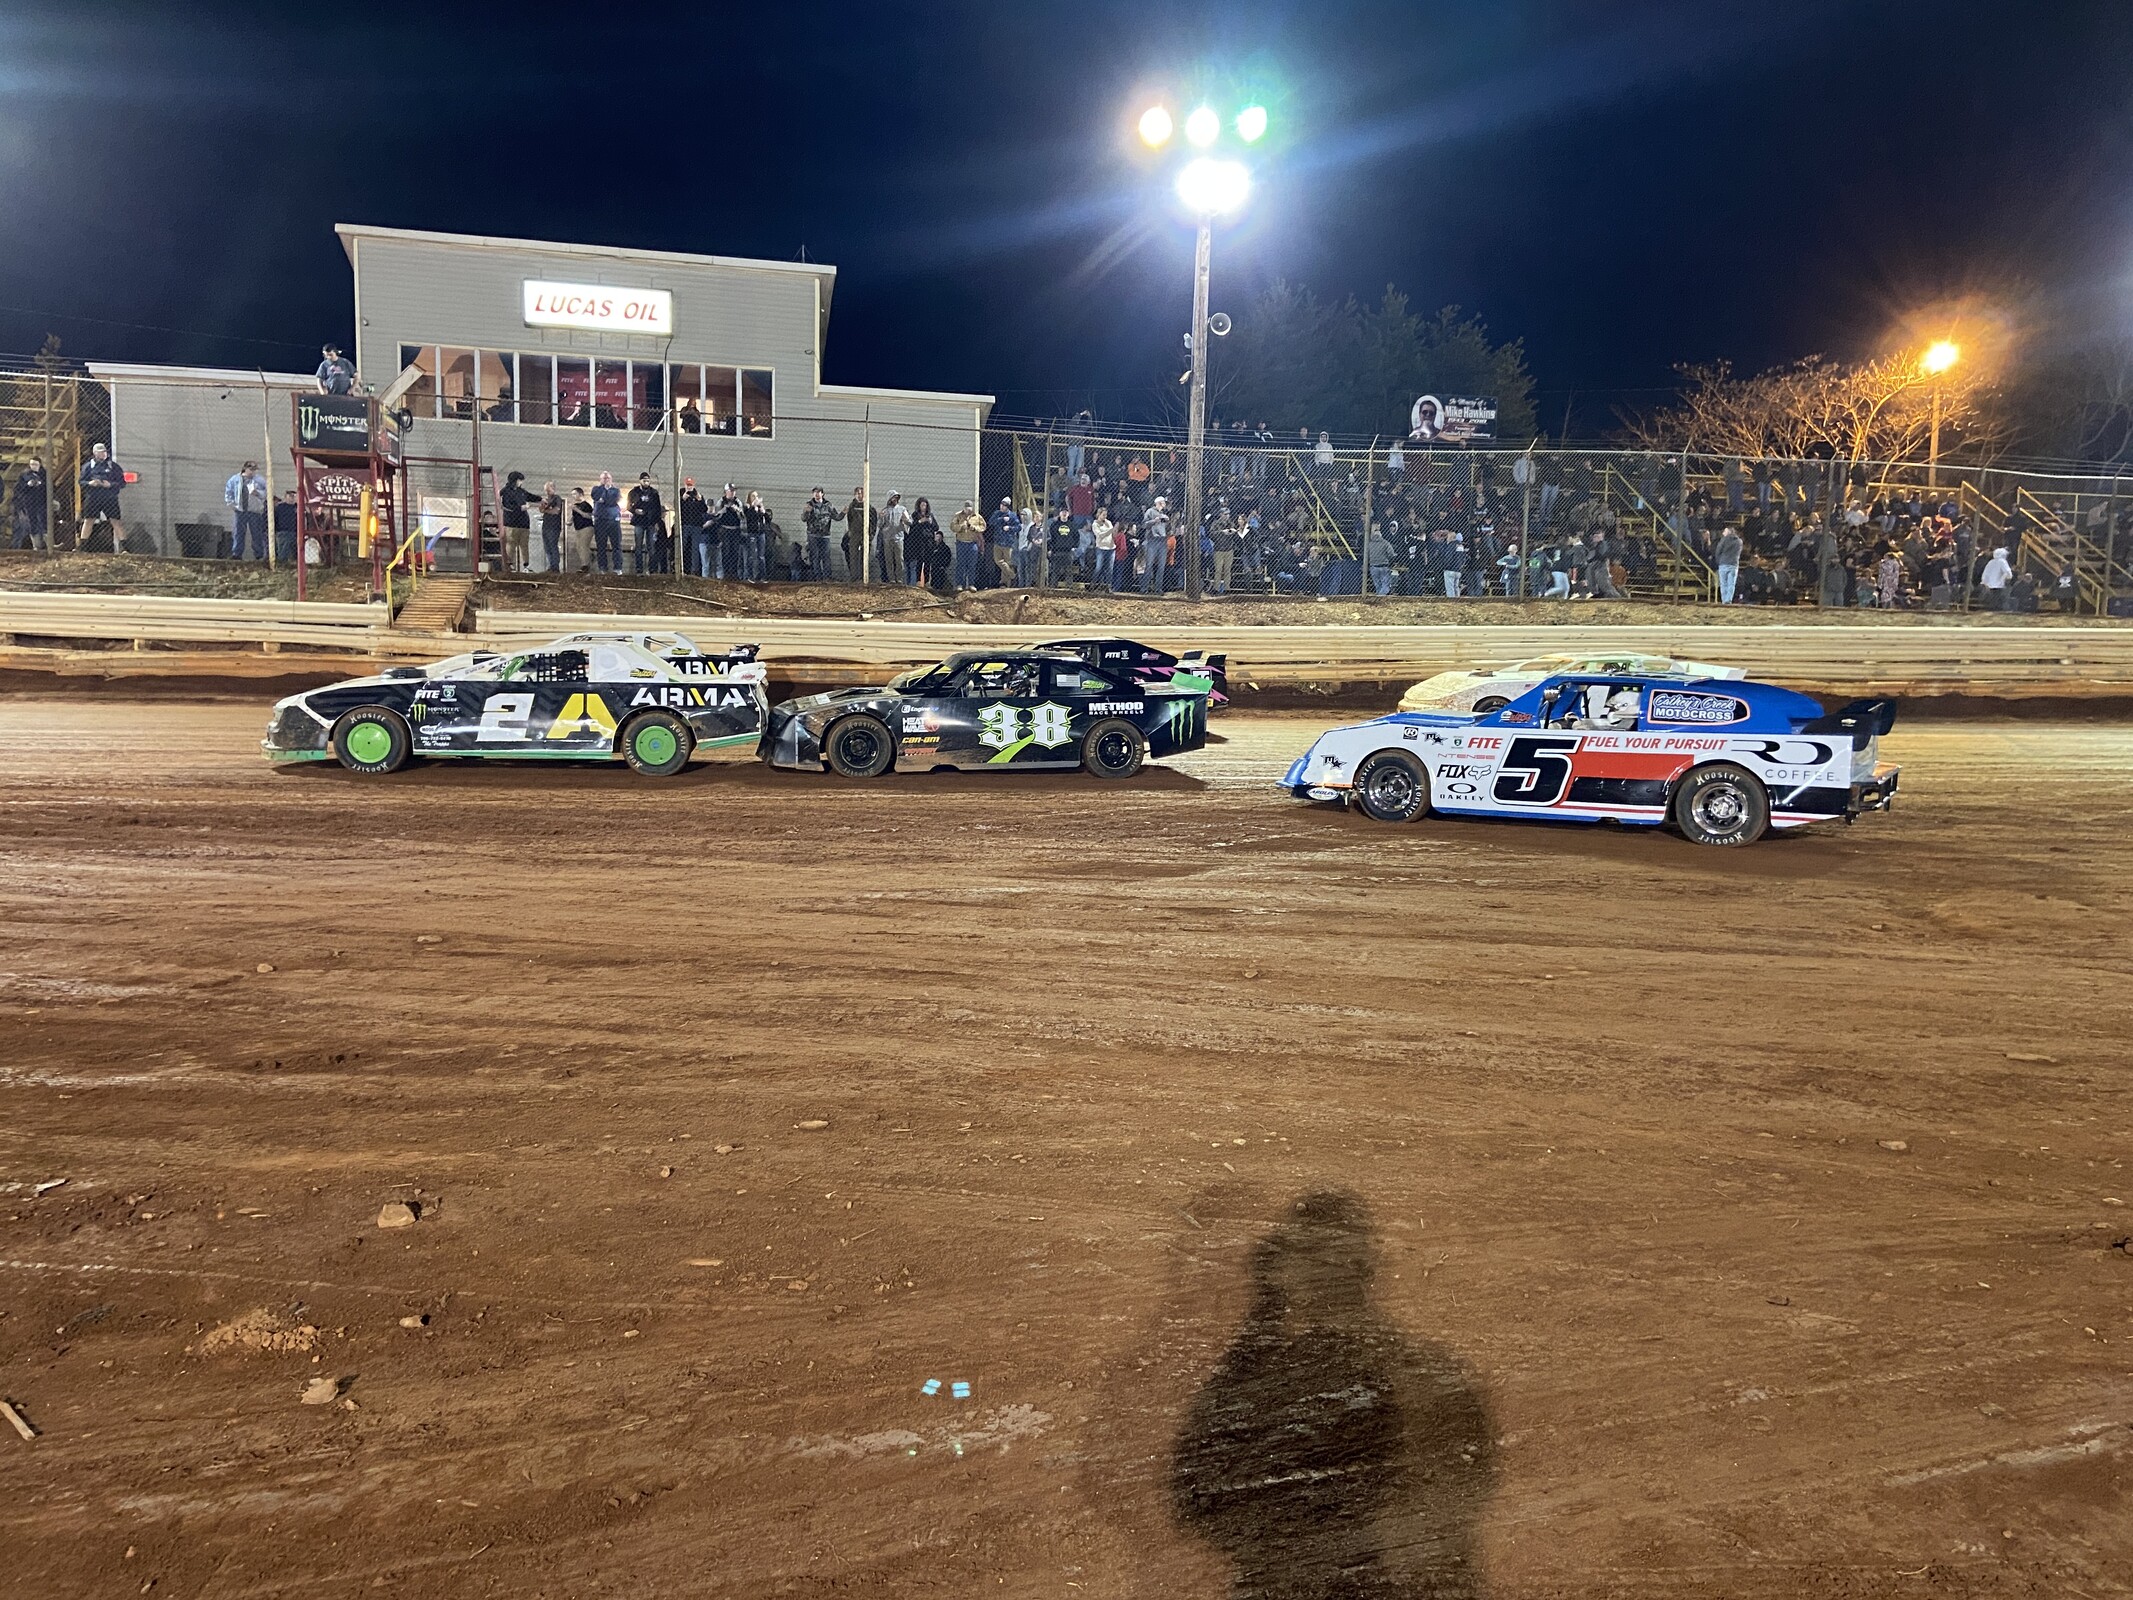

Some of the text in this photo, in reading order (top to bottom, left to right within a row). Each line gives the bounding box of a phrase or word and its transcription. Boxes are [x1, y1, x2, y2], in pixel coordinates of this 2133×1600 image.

[534, 294, 659, 321] LUCAS OIL
[319, 414, 368, 426] MONSTER
[327, 475, 349, 486] PIT
[324, 486, 353, 494] ROW
[414, 689, 440, 699] FITE
[630, 687, 747, 707] ARMA
[1088, 701, 1144, 711] METHOD
[1654, 694, 1736, 710] Cathey's Creek
[349, 712, 386, 724] Hoosier
[475, 693, 536, 742] 2
[1655, 708, 1733, 720] MOTOCROSS
[977, 700, 1073, 751] 38
[1467, 737, 1503, 749] FITE
[1587, 736, 1728, 750] FUEL YOUR PURSUIT
[1358, 760, 1376, 795] Hoosier
[1436, 764, 1471, 779] FOX
[1493, 737, 1580, 804] 5
[1765, 768, 1836, 782] COFFEE
[1695, 771, 1741, 787] Hoosier
[1404, 783, 1424, 818] Hoosier
[1698, 831, 1744, 846] Hoosier
